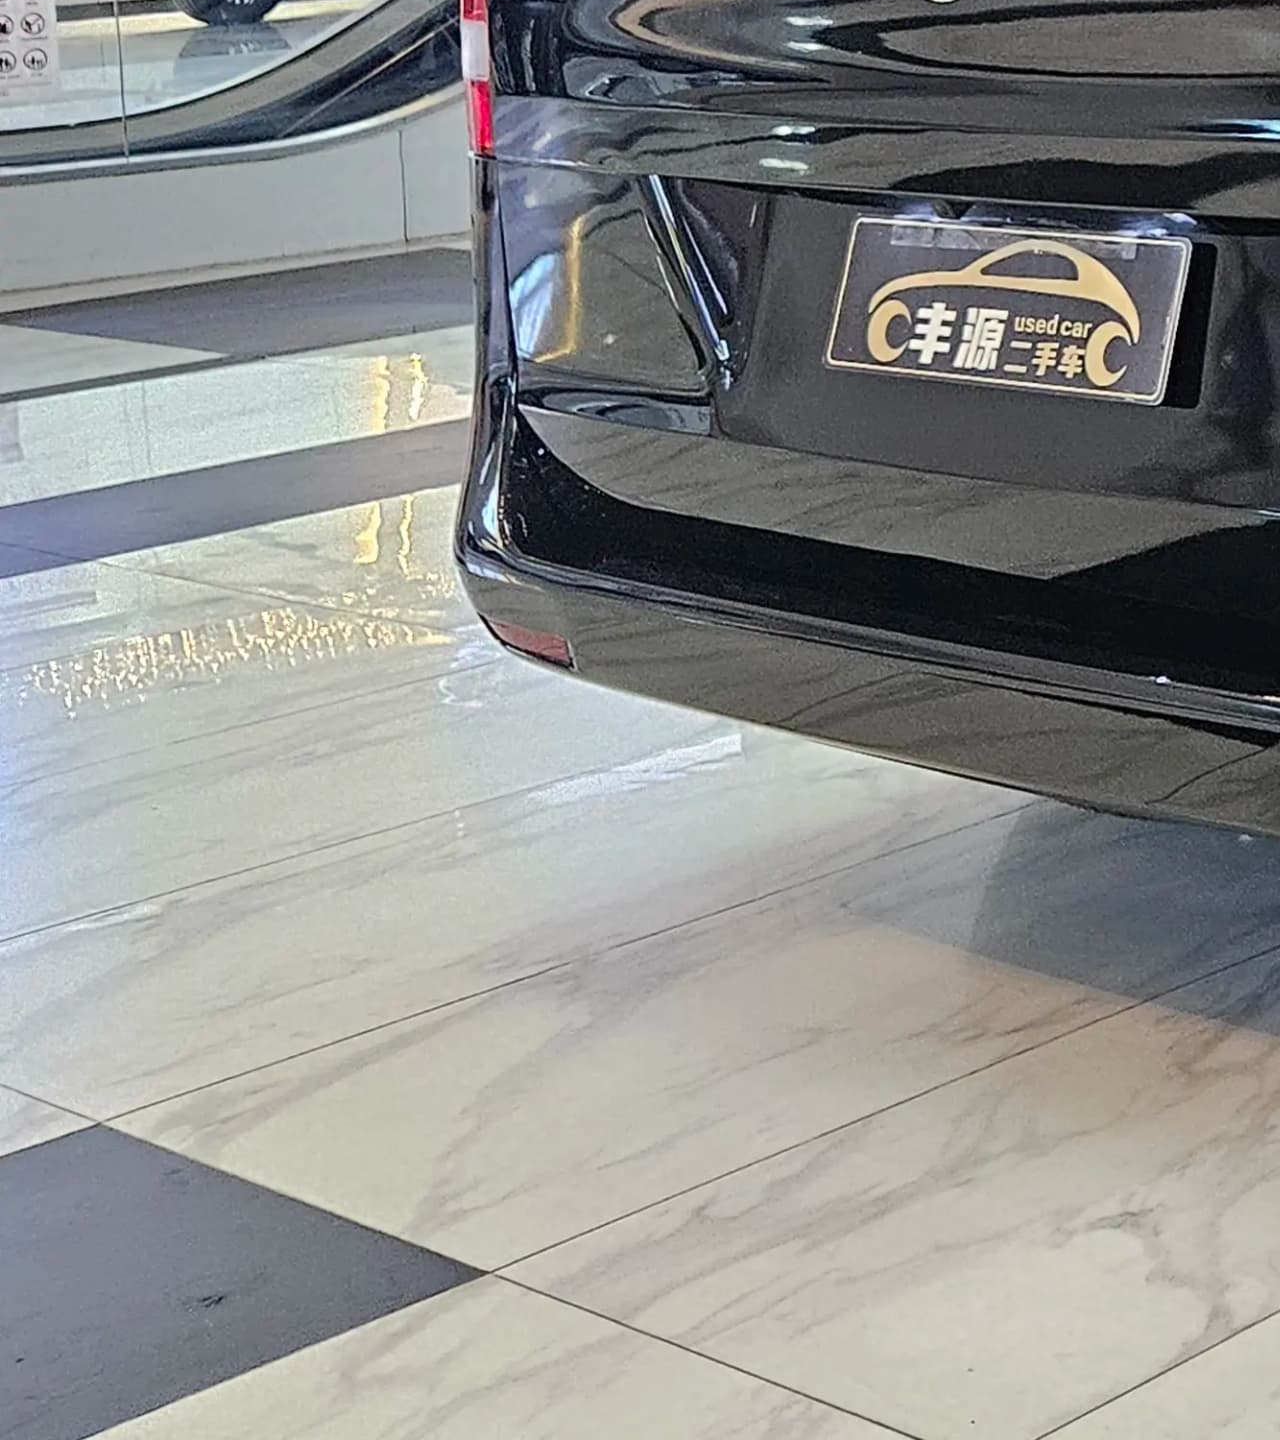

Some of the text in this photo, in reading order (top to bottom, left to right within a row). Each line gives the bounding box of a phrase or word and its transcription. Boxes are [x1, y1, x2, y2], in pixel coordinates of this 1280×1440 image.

[908, 301, 1009, 371] 丰源
[1014, 313, 1093, 339] used car
[1003, 340, 1087, 379] 二手车
